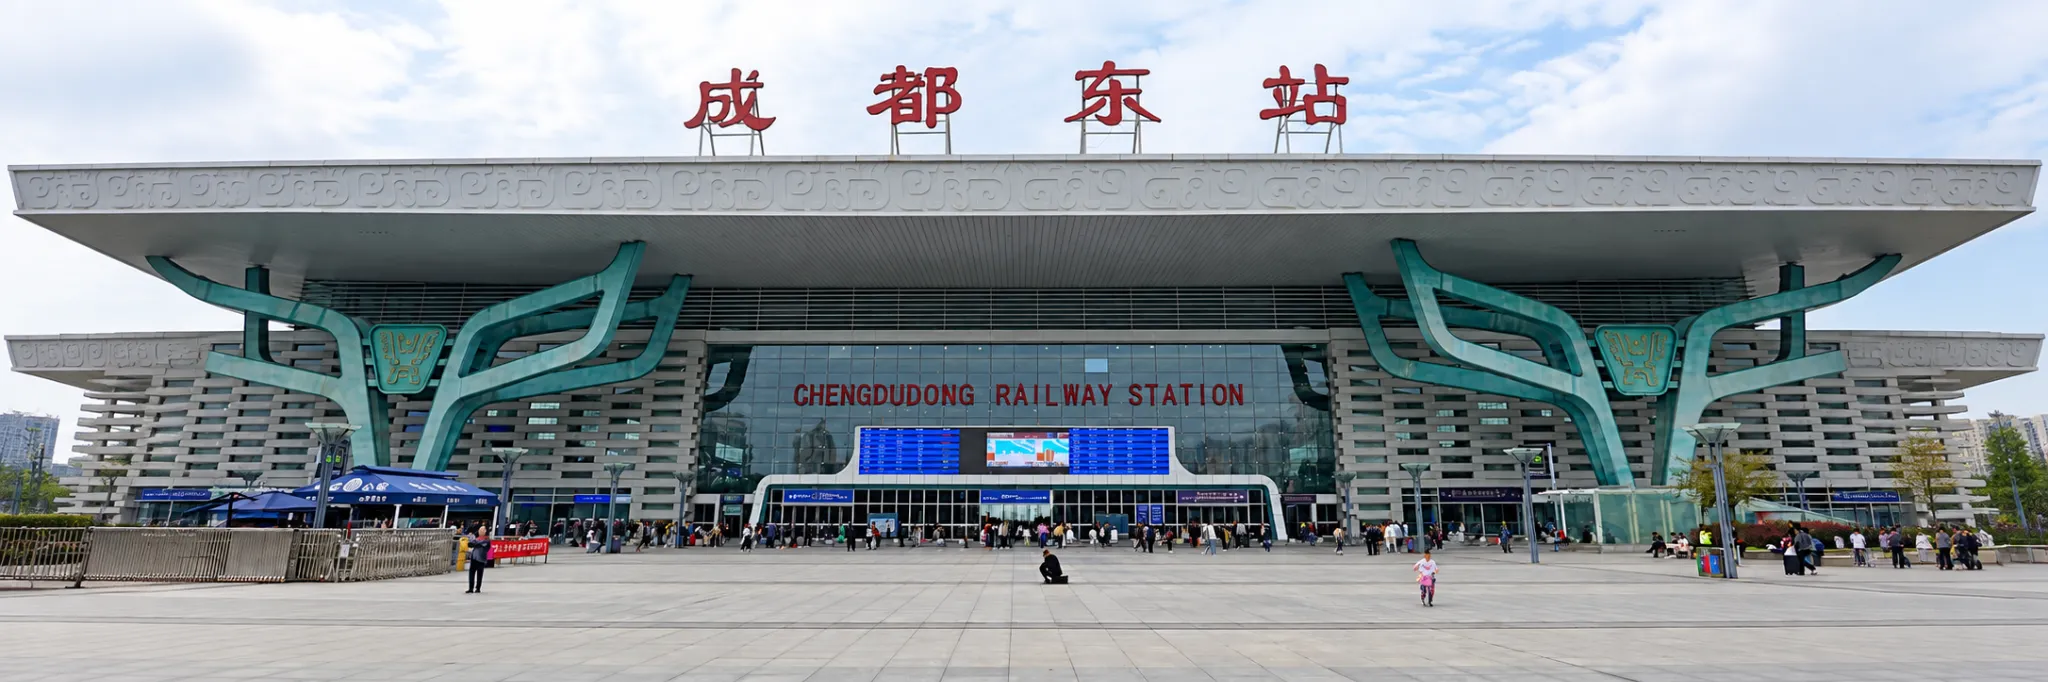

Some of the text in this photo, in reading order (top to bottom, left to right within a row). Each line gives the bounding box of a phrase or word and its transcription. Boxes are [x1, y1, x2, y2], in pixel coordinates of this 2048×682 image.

[685, 61, 1348, 130] 成都东站
[794, 383, 1243, 406] CHENGDUDONG RAILWAY STATION
